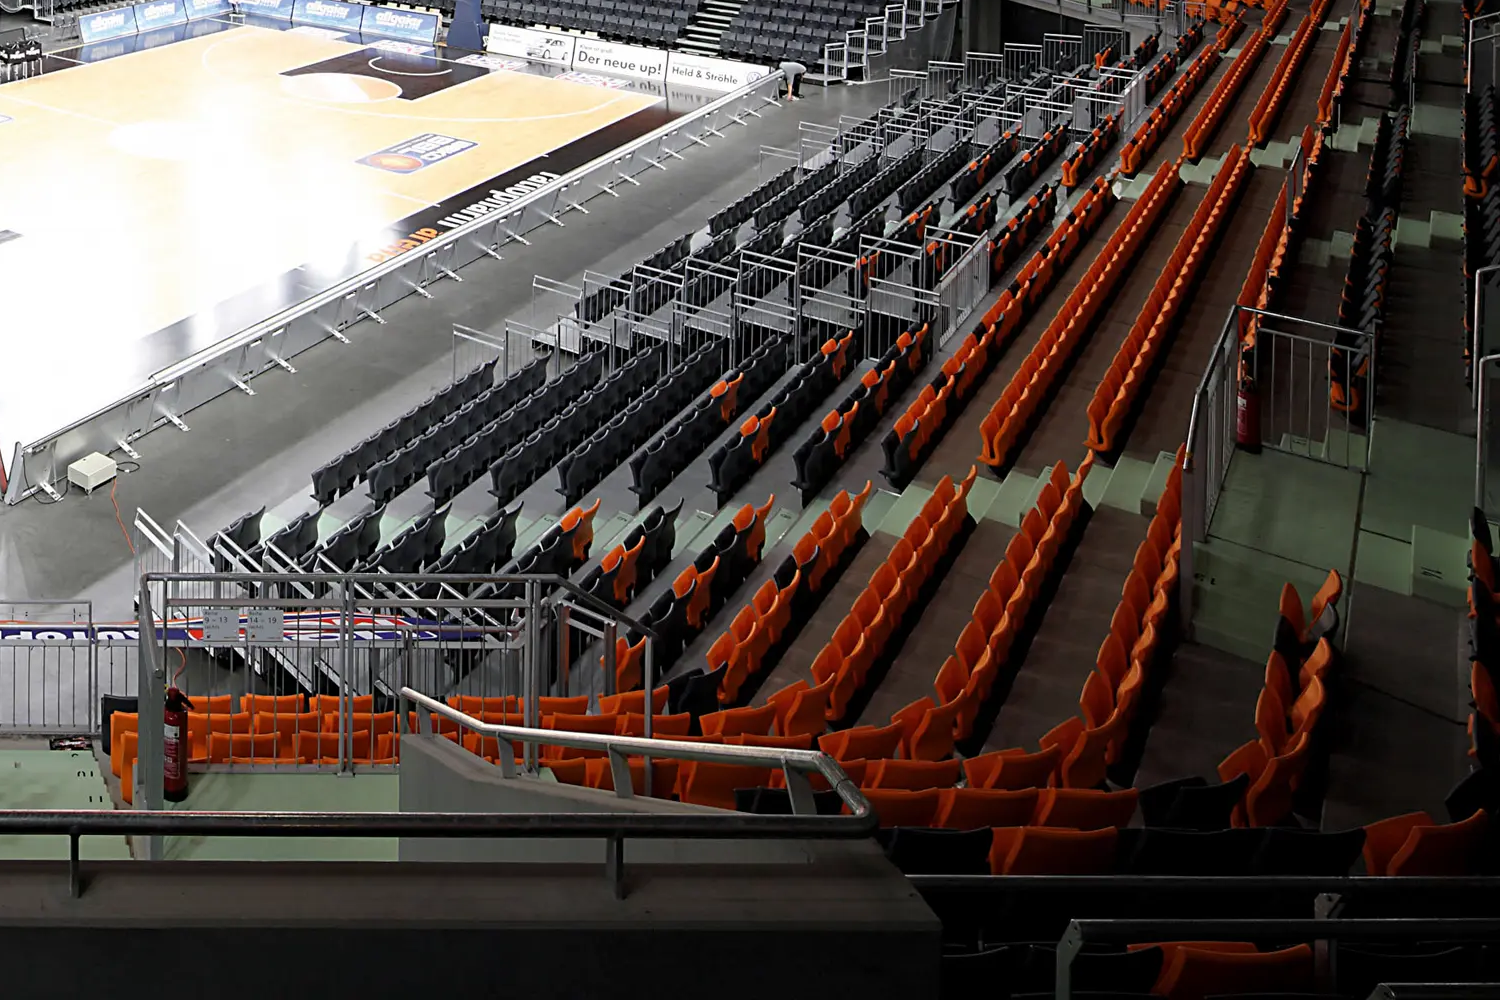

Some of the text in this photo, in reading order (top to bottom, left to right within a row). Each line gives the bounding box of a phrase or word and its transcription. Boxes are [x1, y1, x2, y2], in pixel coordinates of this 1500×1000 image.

[578, 50, 600, 65] Der
[604, 58, 636, 71] neue
[640, 63, 662, 77] up!
[672, 66, 694, 78] Held
[696, 70, 703, 79] &
[705, 70, 739, 86] Ströhle
